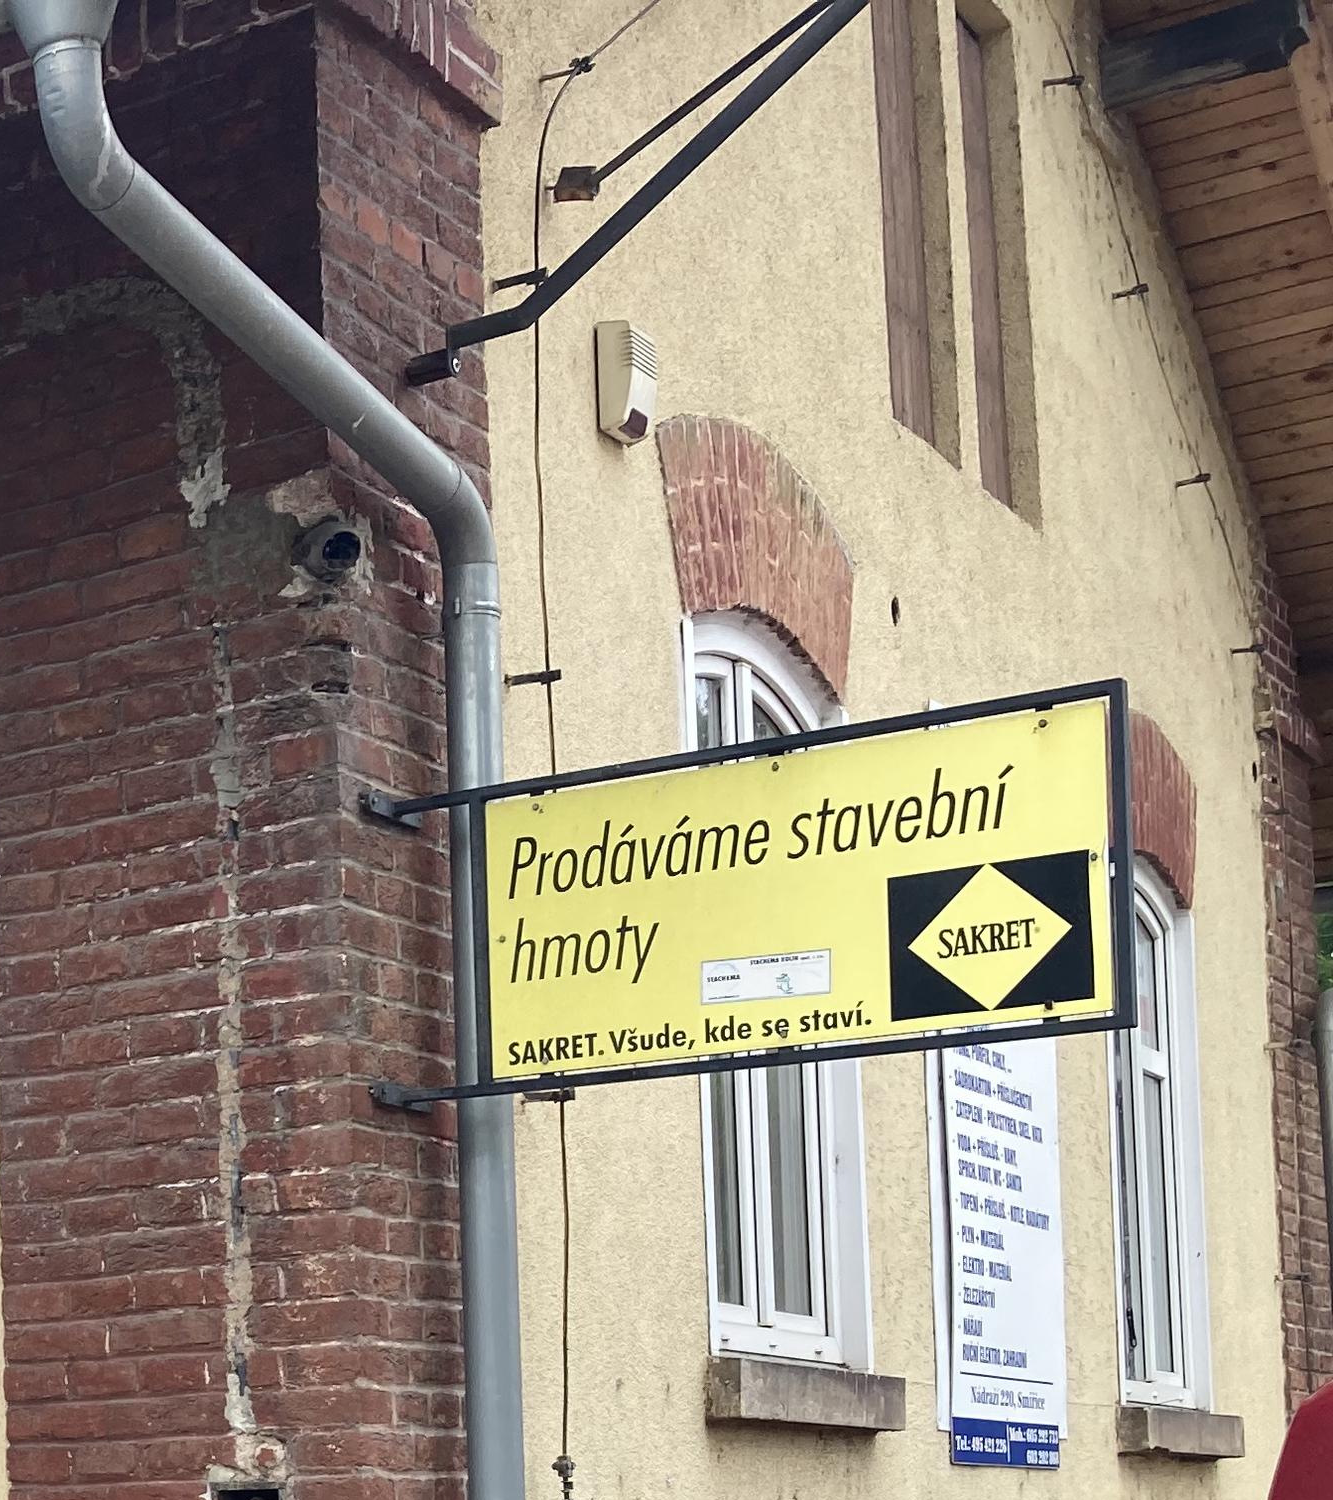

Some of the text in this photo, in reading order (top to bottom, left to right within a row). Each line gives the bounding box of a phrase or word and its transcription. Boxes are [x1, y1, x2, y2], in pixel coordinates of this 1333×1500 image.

[508, 763, 1016, 900] Prodáváme stavební
[510, 915, 660, 984] hmoty
[936, 917, 1036, 960] SAKRET
[508, 1001, 873, 1067] SAKRET. Všude, kde se staví.
[971, 1385, 999, 1406] Nádraží
[1000, 1390, 1016, 1408] 220,
